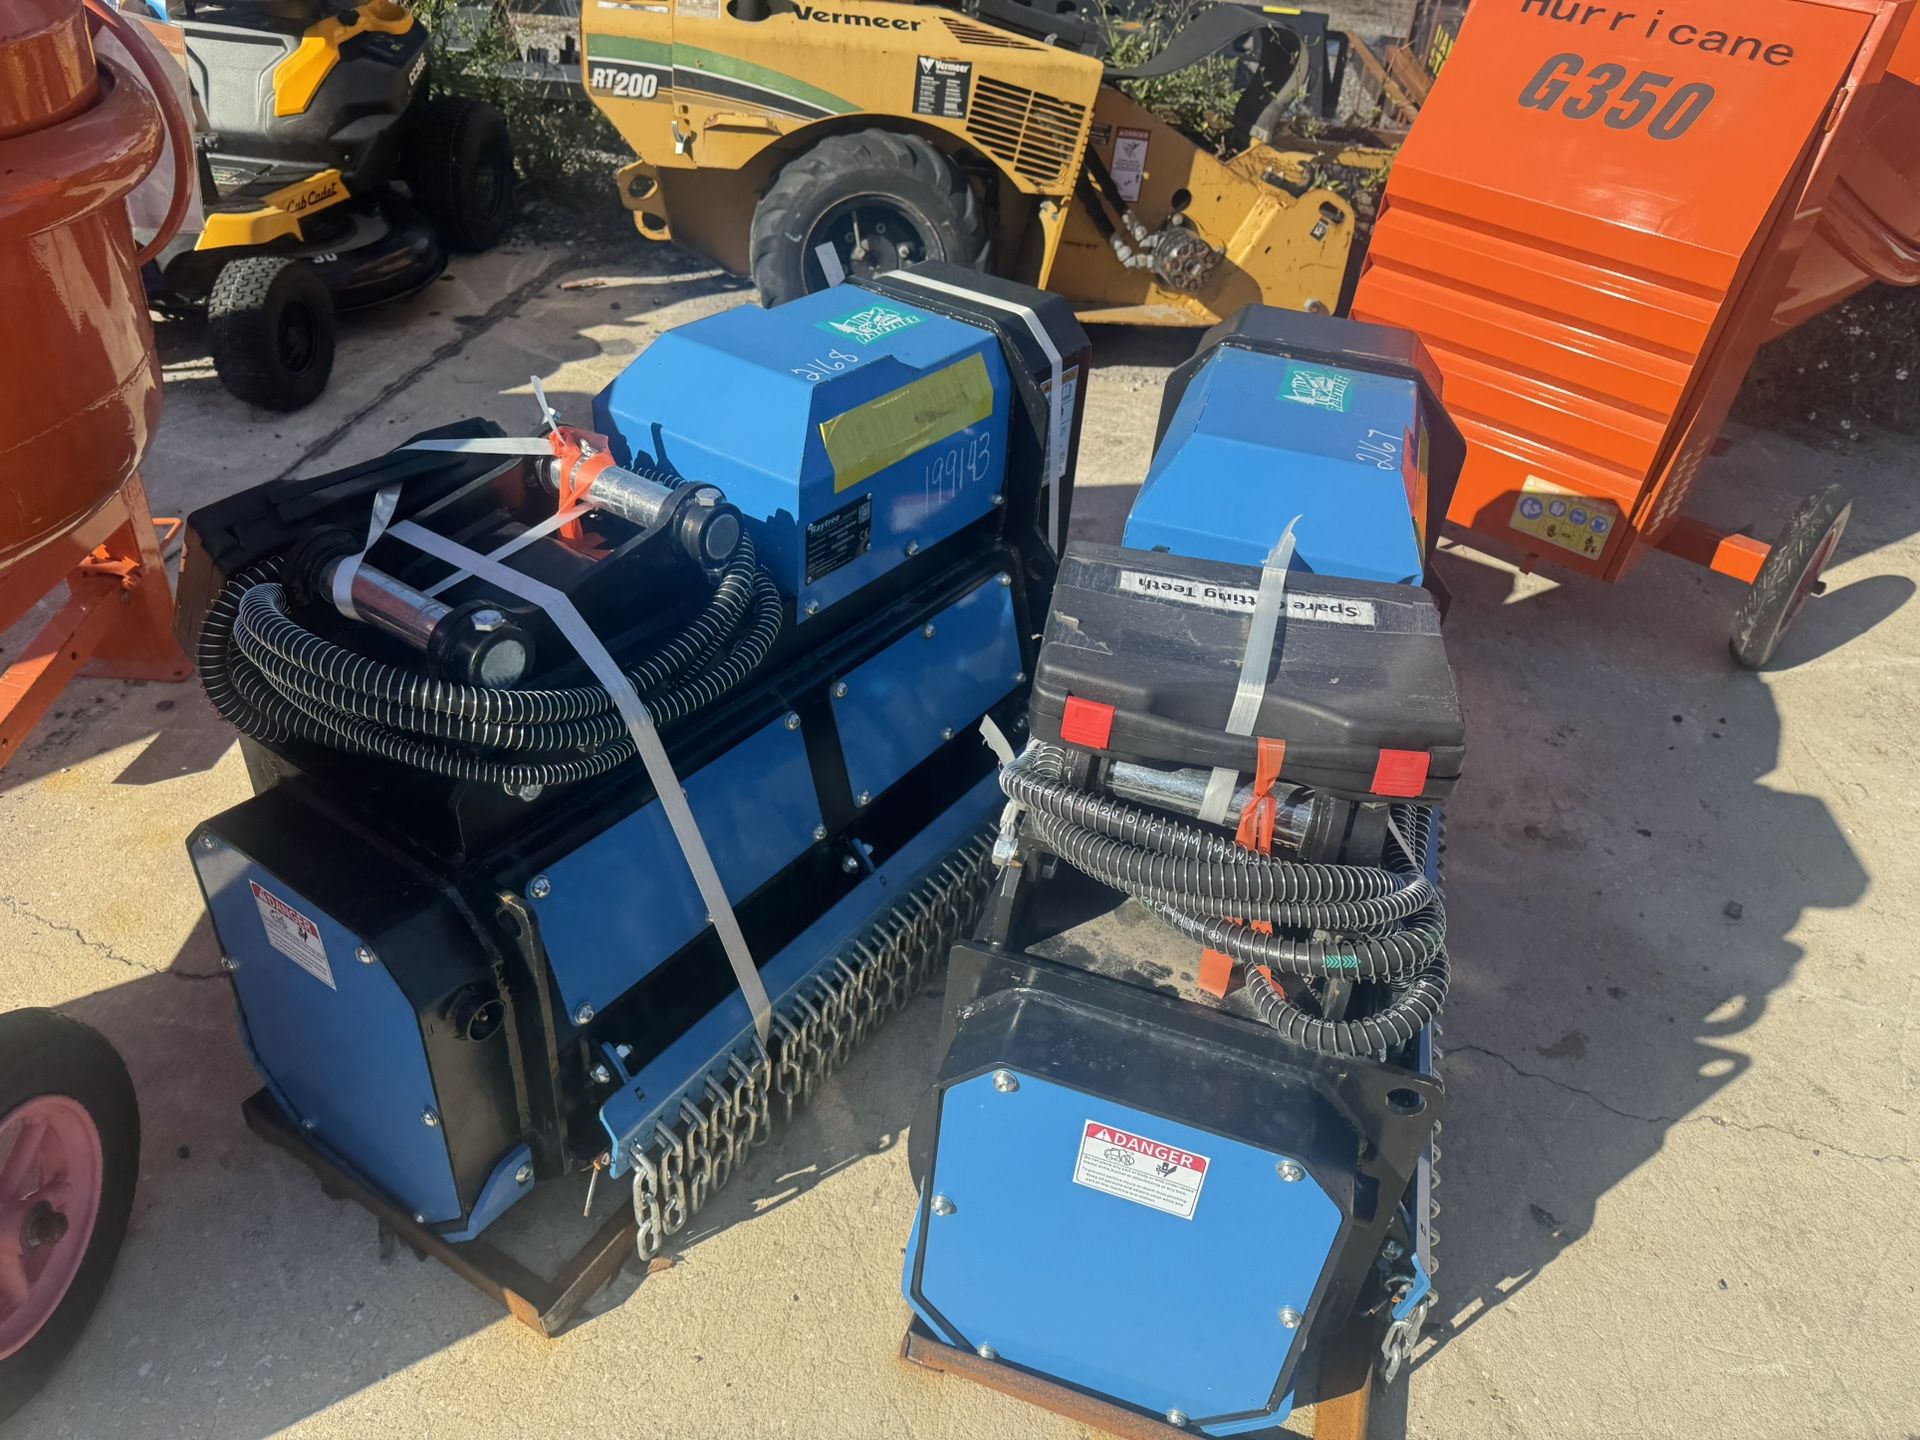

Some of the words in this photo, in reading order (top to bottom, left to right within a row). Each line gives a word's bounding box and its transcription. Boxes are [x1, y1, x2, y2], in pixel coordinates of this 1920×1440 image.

[791, 4, 921, 32] Vermeer
[1520, 0, 1795, 67] Hurricane
[592, 68, 658, 98] RT200
[935, 60, 970, 74] Vermeer
[1518, 52, 1716, 141] G350
[286, 196, 307, 214] Cub
[308, 182, 337, 206] Cadet
[791, 348, 859, 381] 2168
[1355, 429, 1404, 471] 2167
[924, 431, 991, 513] 199143
[1138, 577, 1198, 599] Teeth
[1293, 601, 1359, 619] Spare
[1113, 1131, 1194, 1168] DANGER
